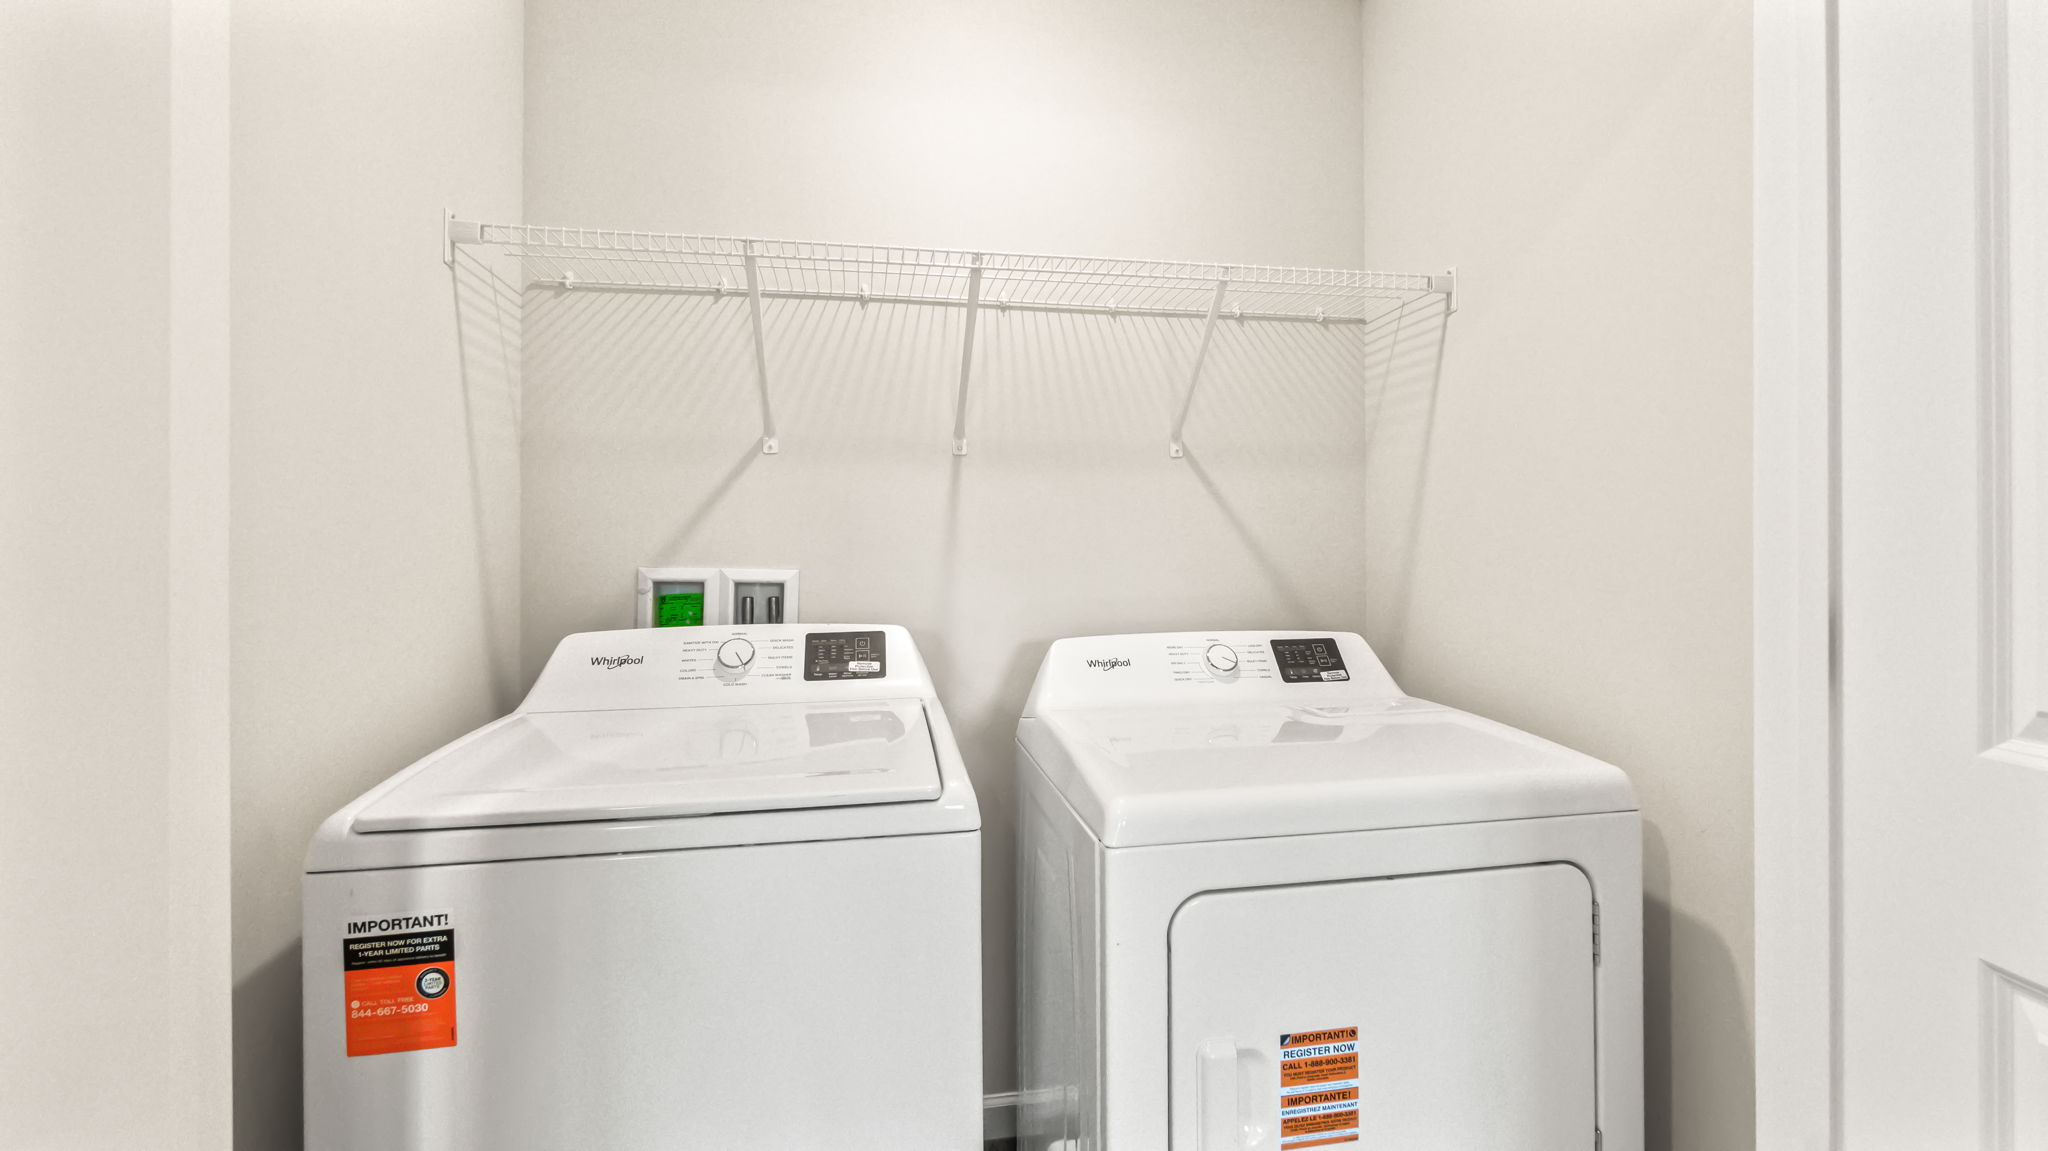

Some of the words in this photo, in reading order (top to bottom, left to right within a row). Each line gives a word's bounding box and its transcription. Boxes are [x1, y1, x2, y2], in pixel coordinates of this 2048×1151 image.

[591, 654, 644, 669] Whirlpool
[1086, 657, 1131, 671] Whirlpool
[348, 914, 449, 935] IMPORTANT!
[350, 941, 386, 950] REGISTER
[387, 939, 405, 947] NOW
[423, 935, 448, 943] EXTRA
[358, 949, 384, 957] 1-YEAR
[385, 947, 415, 955] LIMITED
[416, 944, 440, 952] PARTS
[351, 1002, 429, 1019] 844-667-5030
[1291, 1030, 1349, 1044] IMPORTANT!
[1283, 1045, 1331, 1059] REGISTER
[1333, 1043, 1356, 1053] NOW
[1283, 1061, 1302, 1071] CALL
[1287, 1091, 1351, 1106] IMPORTANTE!
[1282, 1106, 1321, 1116] ENREGISTREZ
[1322, 1101, 1358, 1111] MAINTENANT
[1283, 1115, 1309, 1124] APPELEZ
